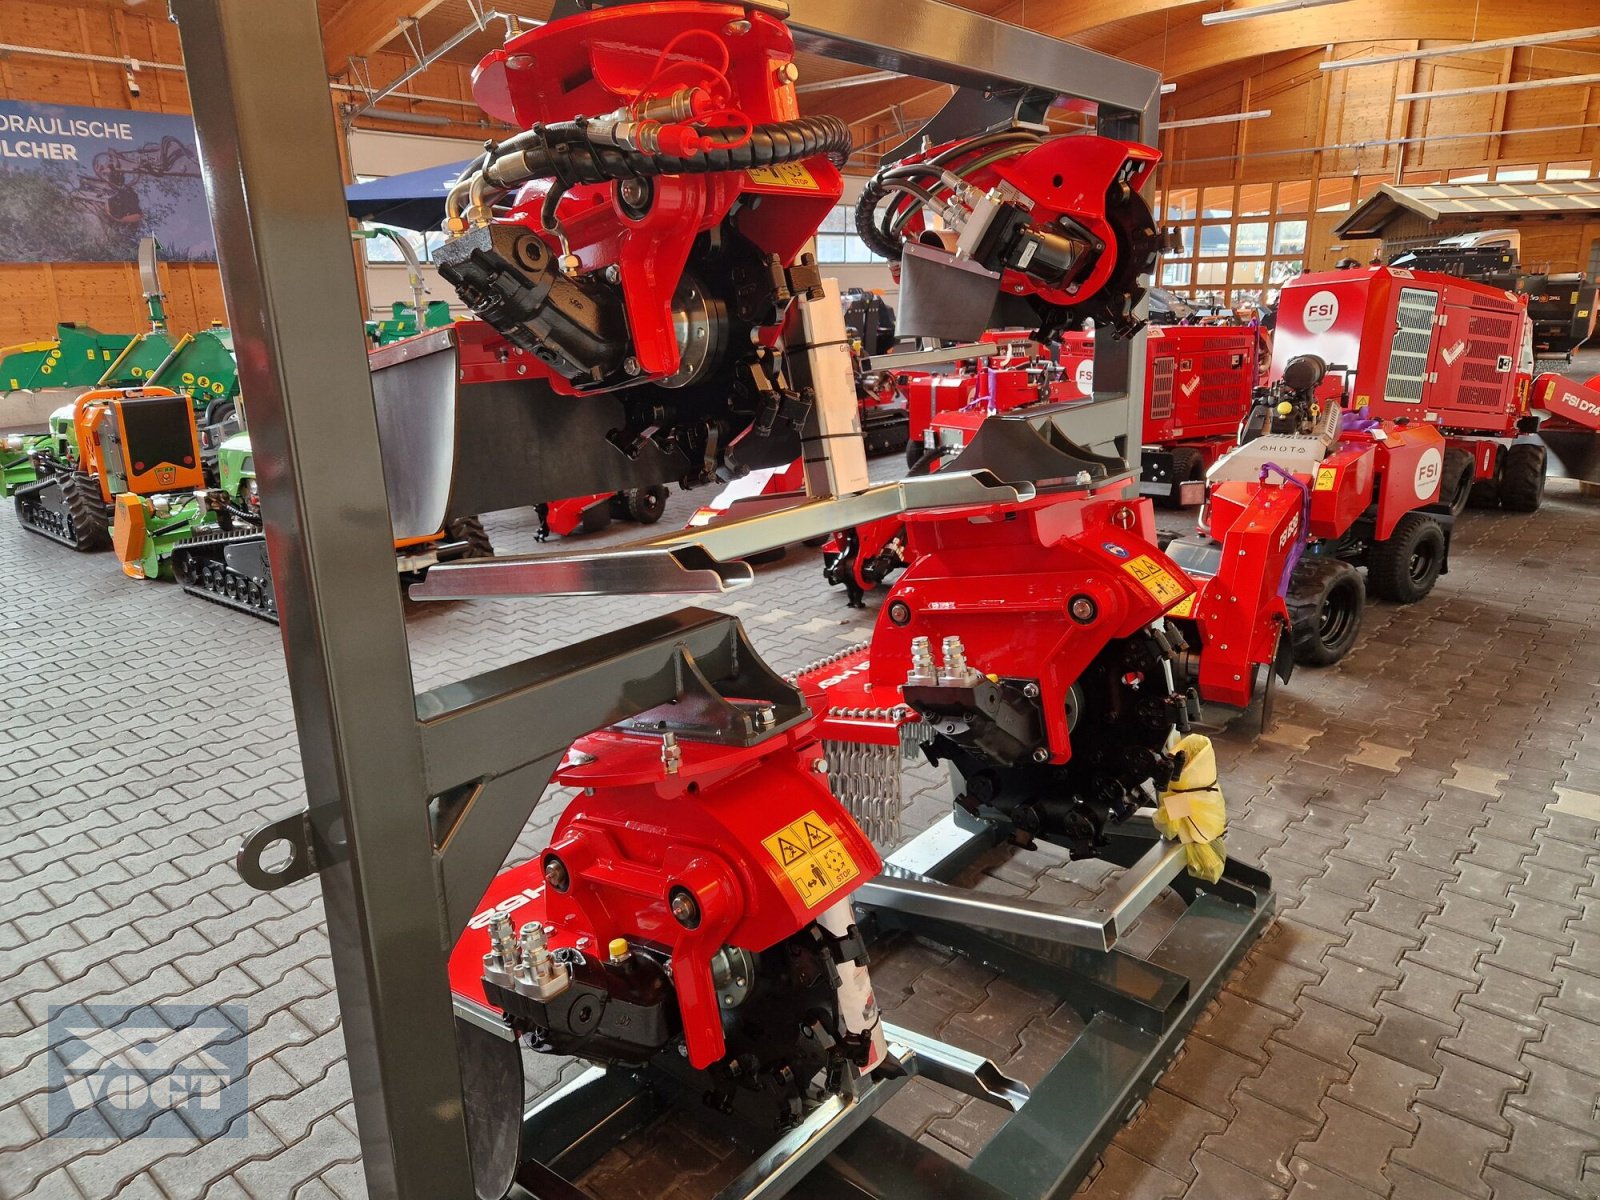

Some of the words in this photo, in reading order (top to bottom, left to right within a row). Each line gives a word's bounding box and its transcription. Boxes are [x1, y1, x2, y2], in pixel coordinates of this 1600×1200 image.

[0, 139, 79, 161] LCHER
[1308, 304, 1334, 317] FSI
[1079, 370, 1093, 381] FS
[1561, 392, 1581, 408] FSI
[1418, 462, 1438, 480] FSI
[836, 868, 852, 883] STOP
